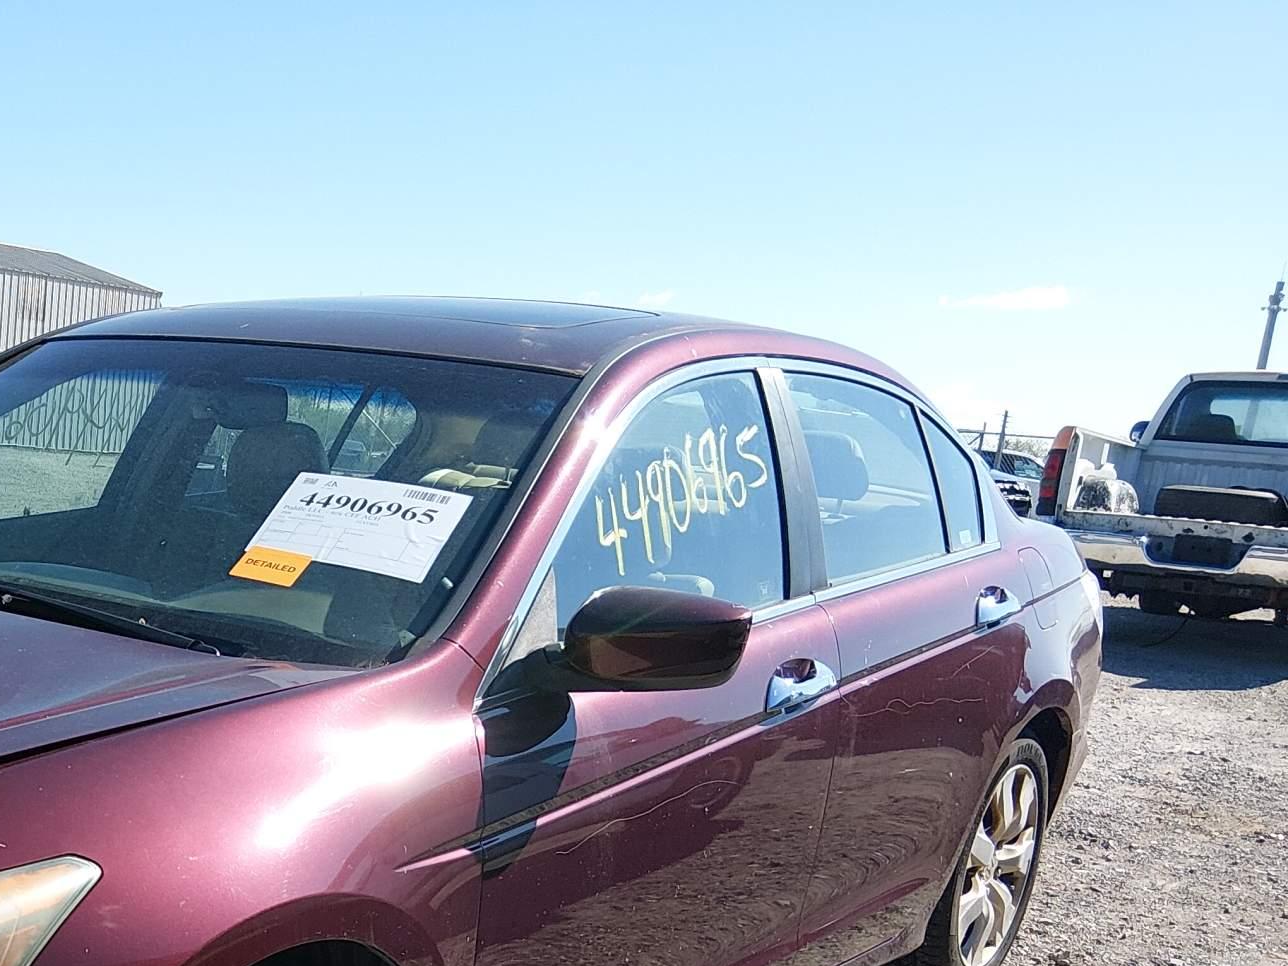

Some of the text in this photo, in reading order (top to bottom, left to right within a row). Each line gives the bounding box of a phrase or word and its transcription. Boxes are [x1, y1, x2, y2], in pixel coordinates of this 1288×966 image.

[299, 490, 440, 526] 44906965
[594, 424, 769, 577] 44906965
[245, 557, 297, 574] DETAILED
